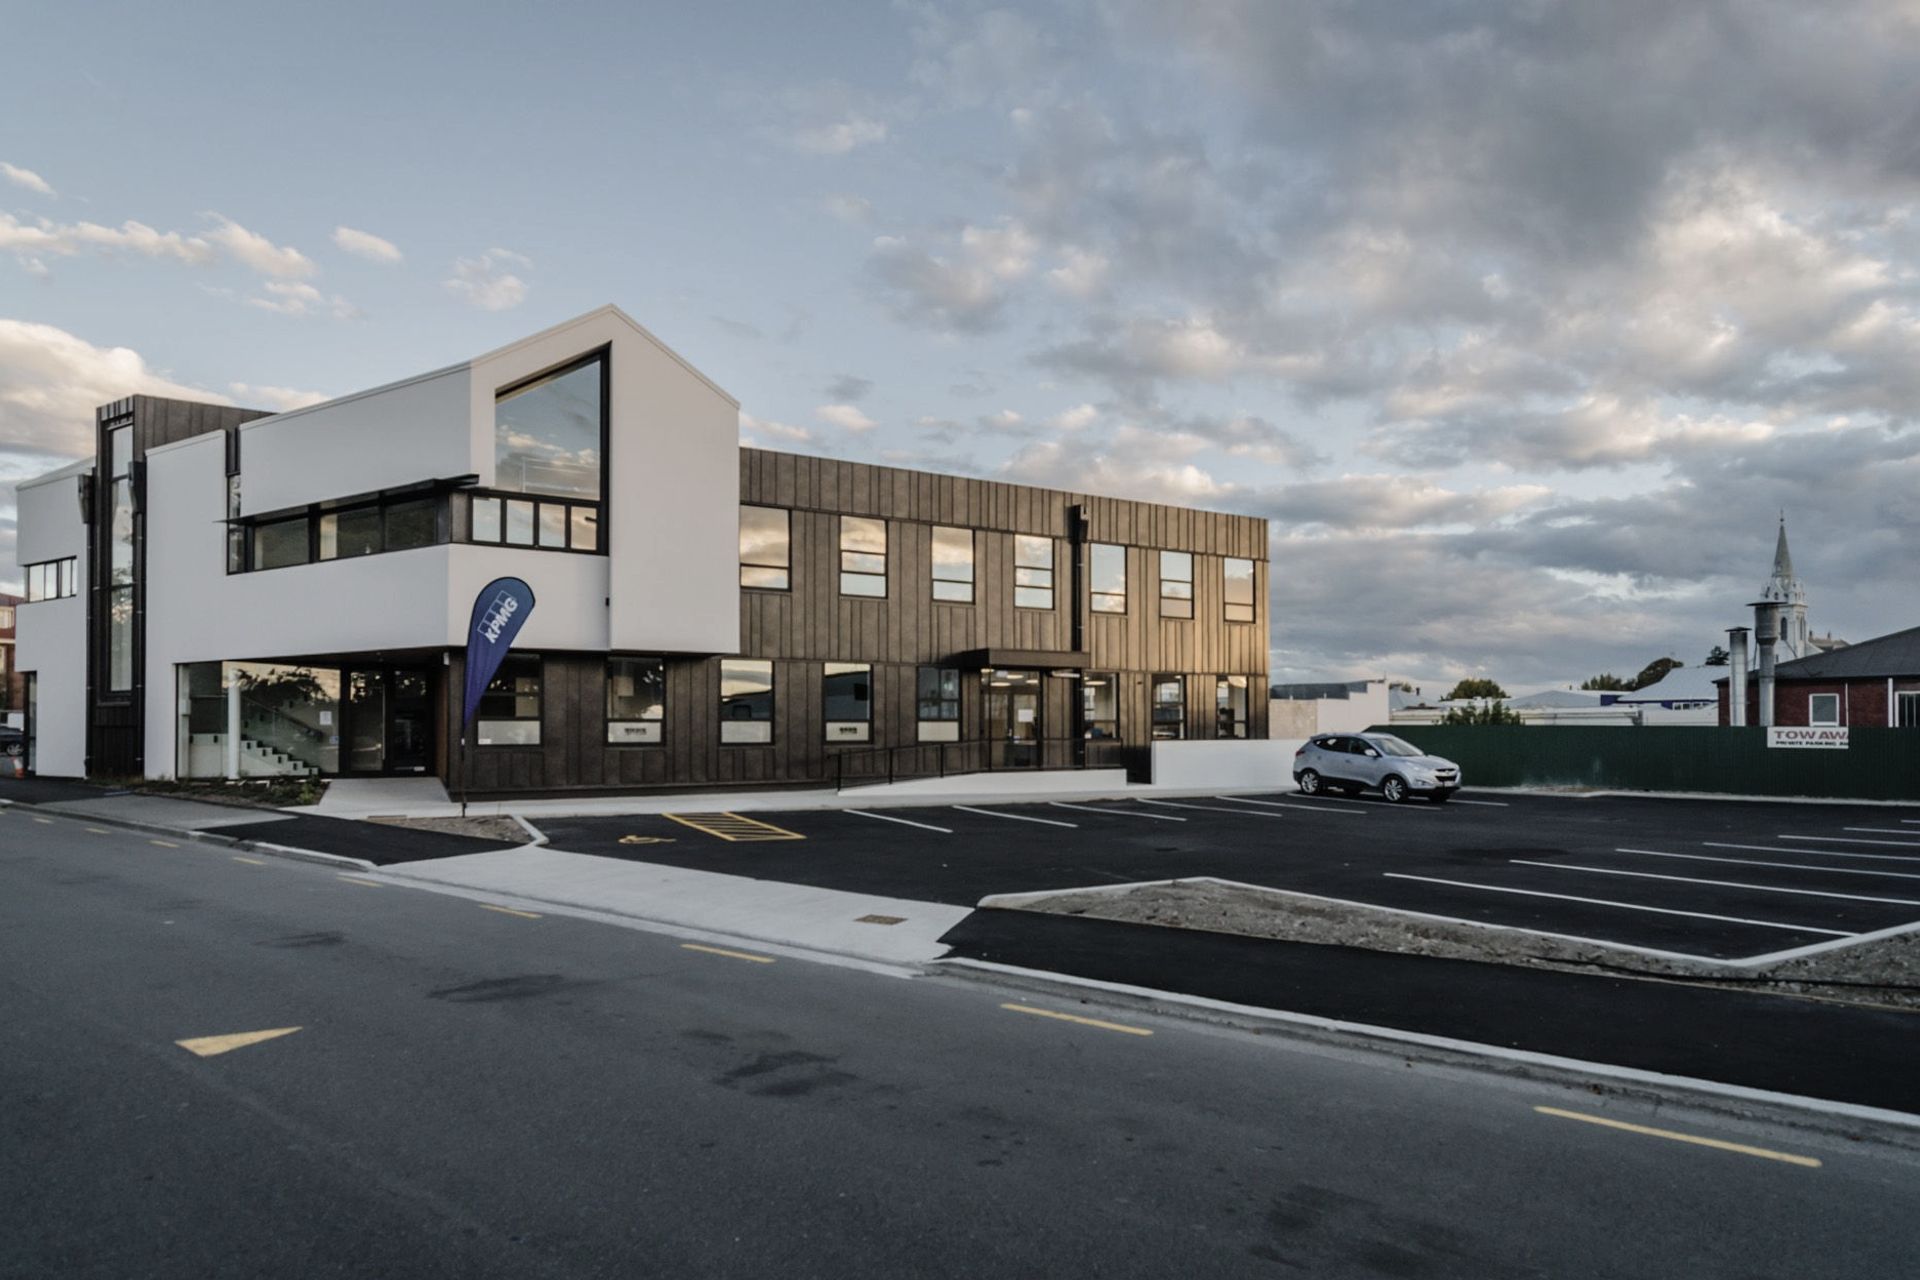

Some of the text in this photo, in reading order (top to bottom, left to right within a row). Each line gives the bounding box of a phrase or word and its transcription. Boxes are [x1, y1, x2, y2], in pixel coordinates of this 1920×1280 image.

[485, 597, 518, 644] KPMG
[1774, 730, 1849, 740] TOW AW
